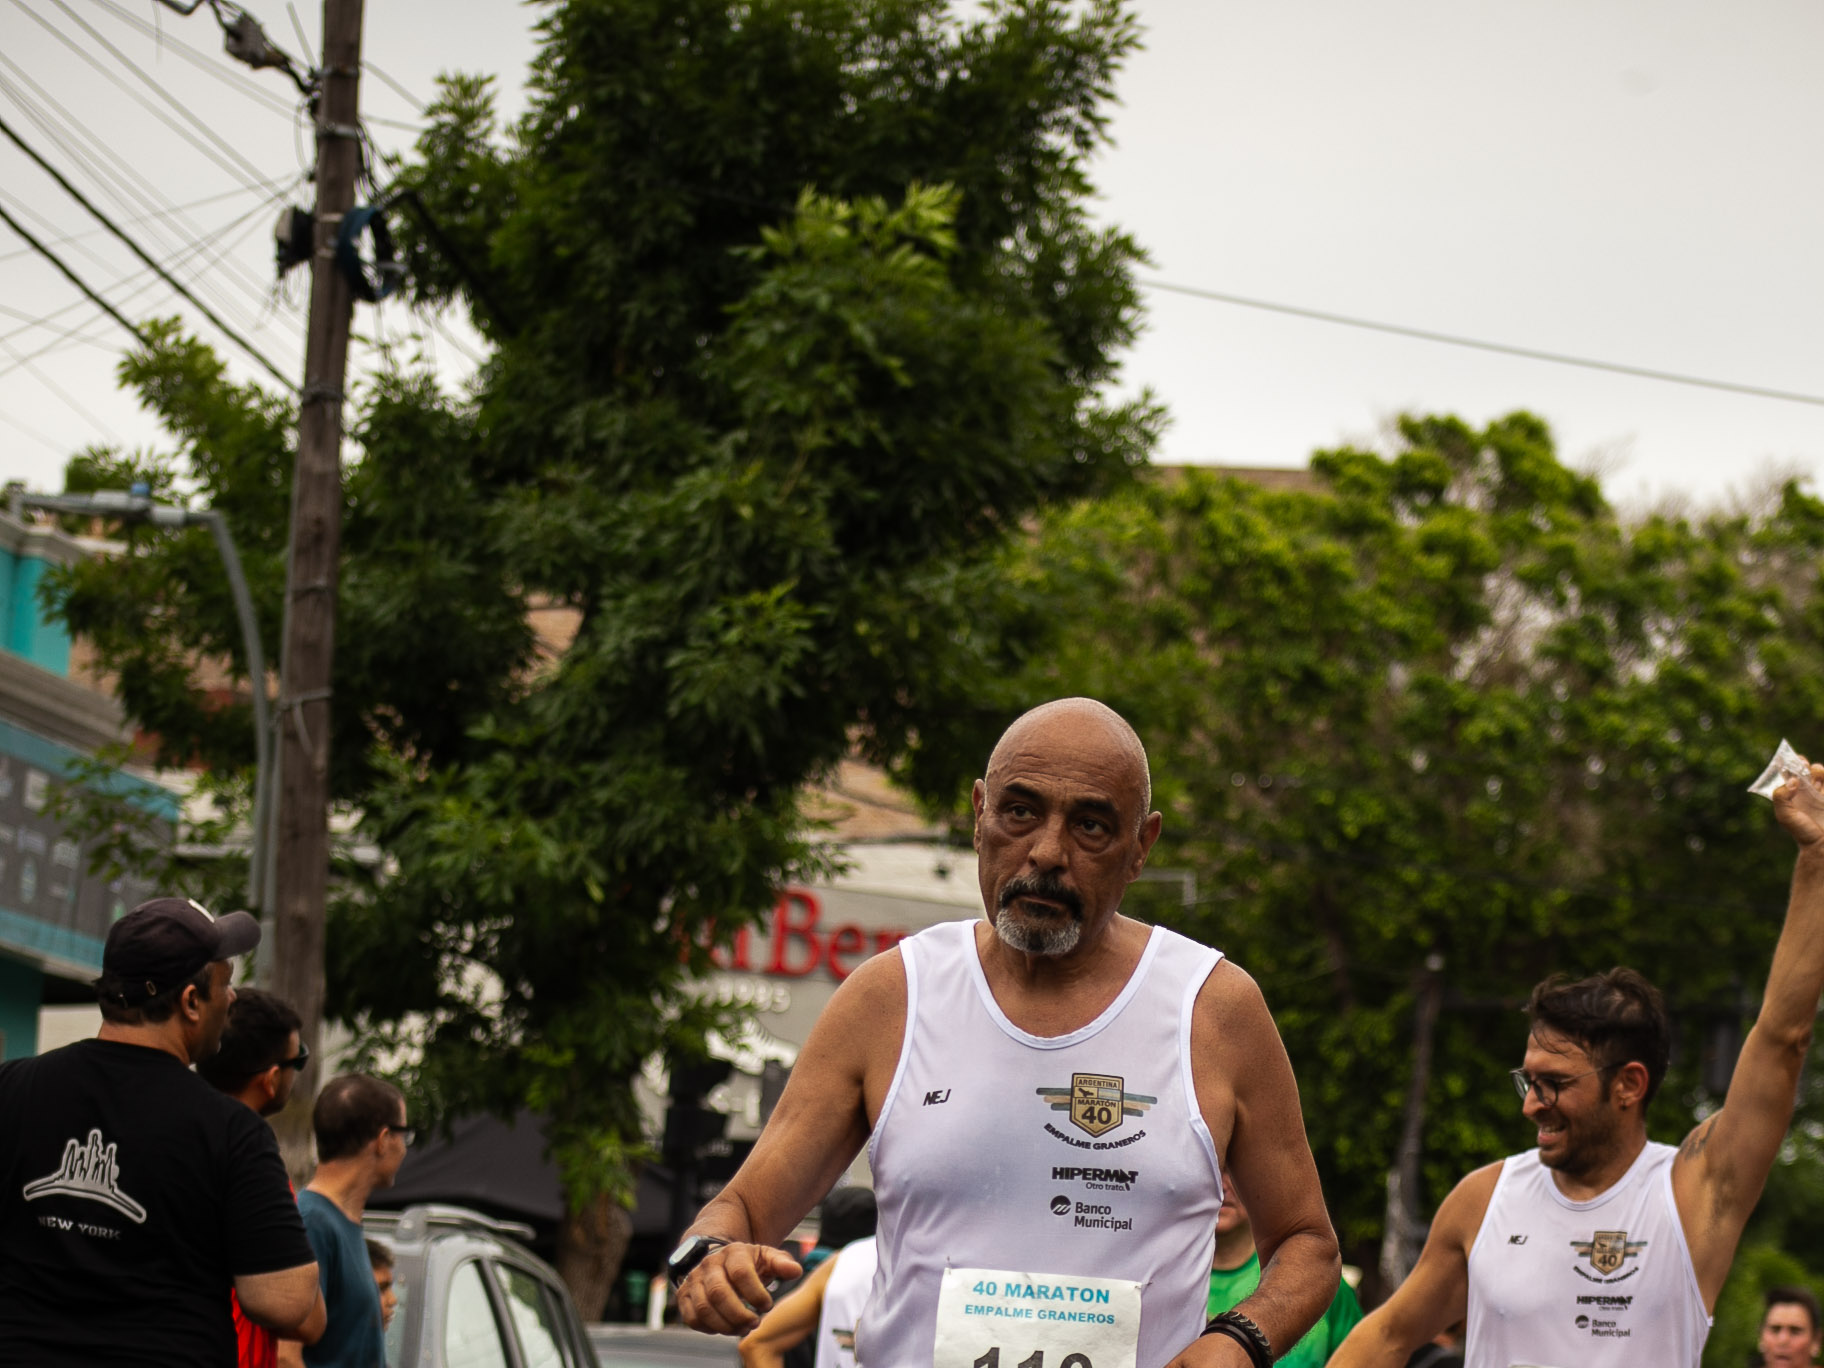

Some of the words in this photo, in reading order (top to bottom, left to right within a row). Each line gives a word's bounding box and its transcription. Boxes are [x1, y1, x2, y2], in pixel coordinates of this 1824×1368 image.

[1078, 1078, 1118, 1089] ARGENTINA
[923, 1088, 952, 1106] NEJ
[1081, 1107, 1112, 1125] 40
[1044, 1123, 1091, 1150] EMPALME
[1092, 1129, 1147, 1150] GRANEROS
[1086, 1182, 1104, 1190] Otro
[1075, 1202, 1112, 1214] Banco
[78, 1223, 120, 1239] YORK
[1074, 1216, 1132, 1232] Municipal
[1598, 1255, 1617, 1267] 40
[972, 1280, 997, 1296] 40
[1004, 1283, 1110, 1304] MARATON
[964, 1305, 1033, 1319] EMPALME
[1037, 1309, 1115, 1324] GRANEROS
[1592, 1319, 1616, 1328] Banco
[1591, 1329, 1631, 1338] Municipal
